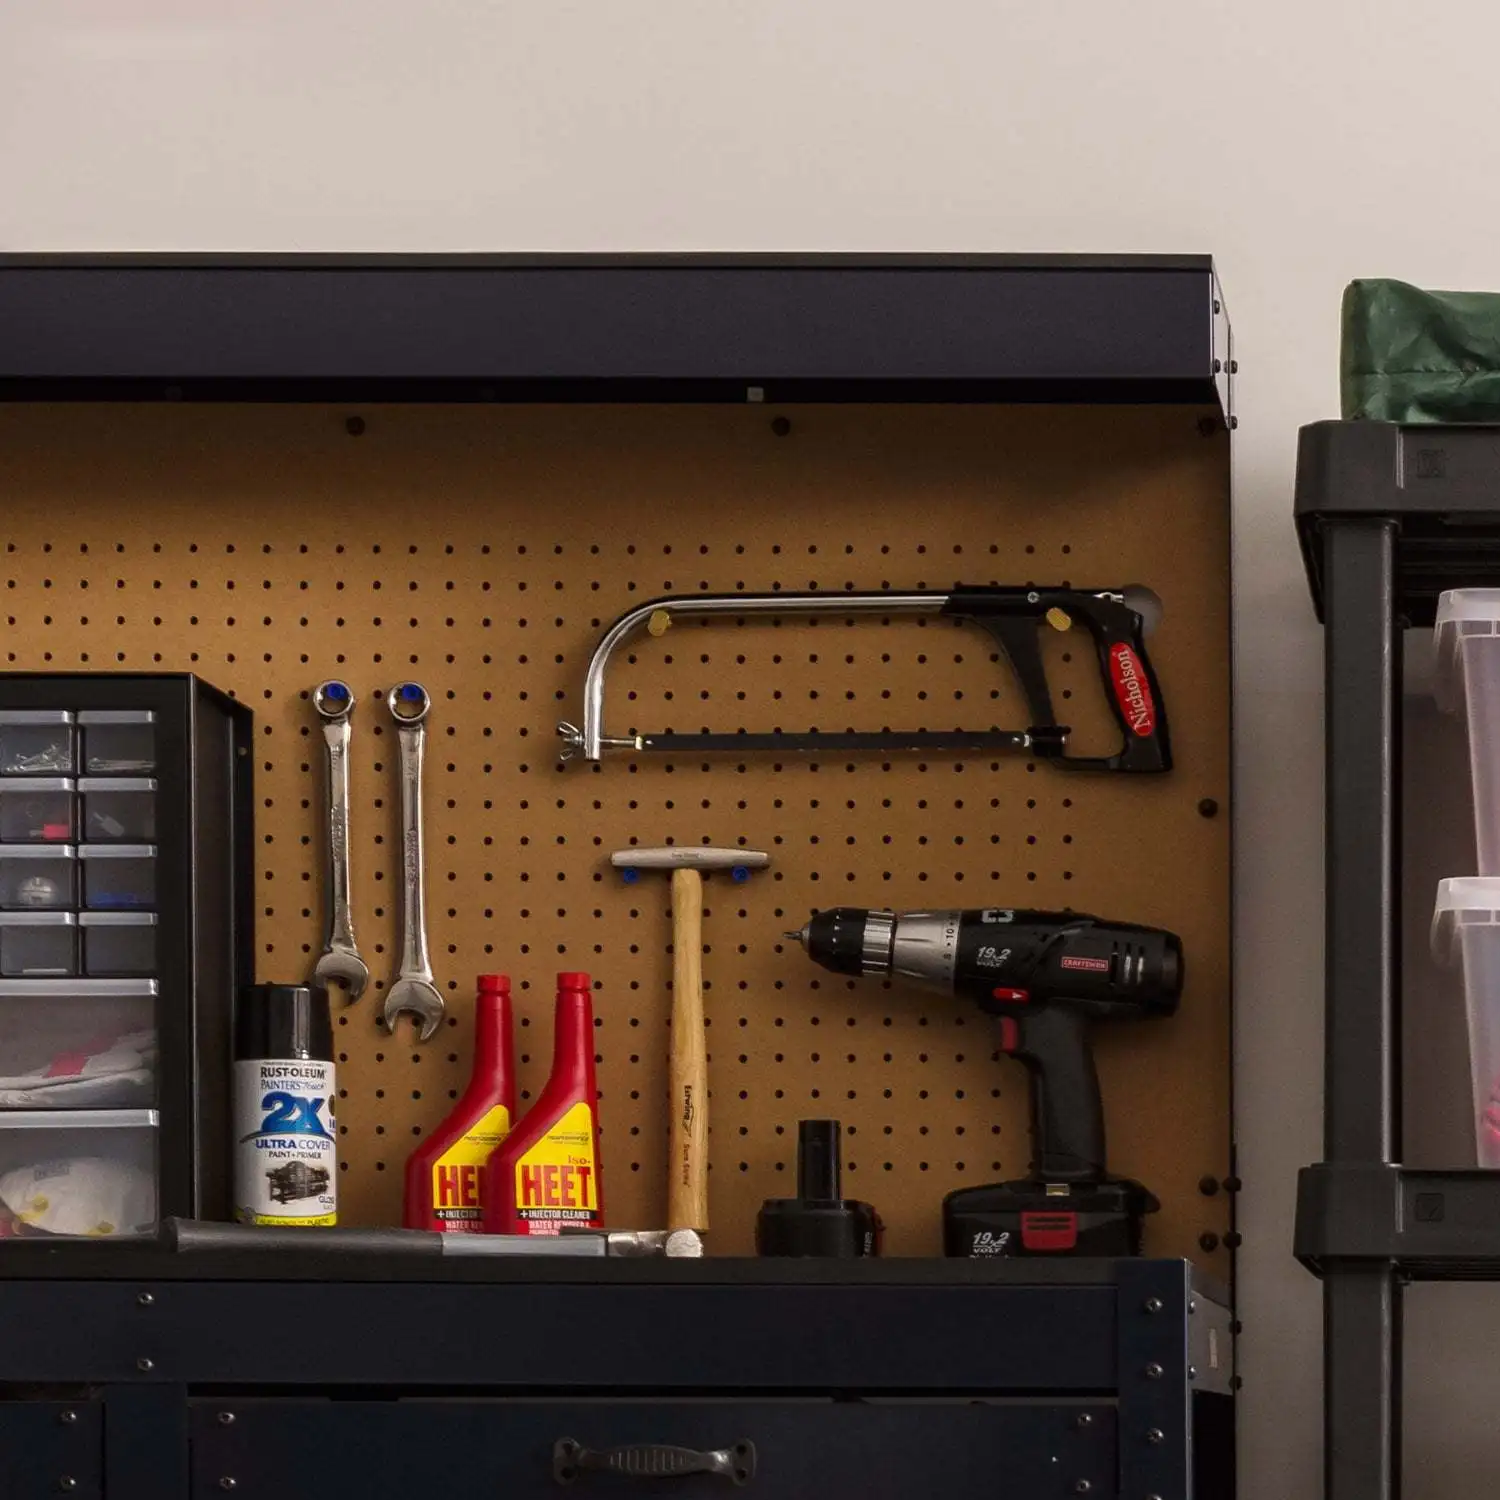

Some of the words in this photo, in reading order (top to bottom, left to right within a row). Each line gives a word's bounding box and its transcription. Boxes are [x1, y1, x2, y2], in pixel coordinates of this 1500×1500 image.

[1118, 650, 1150, 730] Nicholson
[978, 946, 1012, 961] 19.2
[261, 1091, 326, 1132] 2X
[255, 1139, 297, 1150] ULTRA
[298, 1140, 331, 1151] COVER
[521, 1165, 591, 1208] HEET
[528, 1210, 561, 1219] INJECTOR
[562, 1210, 591, 1219] CLEANER
[528, 1220, 552, 1230] WATER
[973, 1232, 1010, 1245] 19.2
